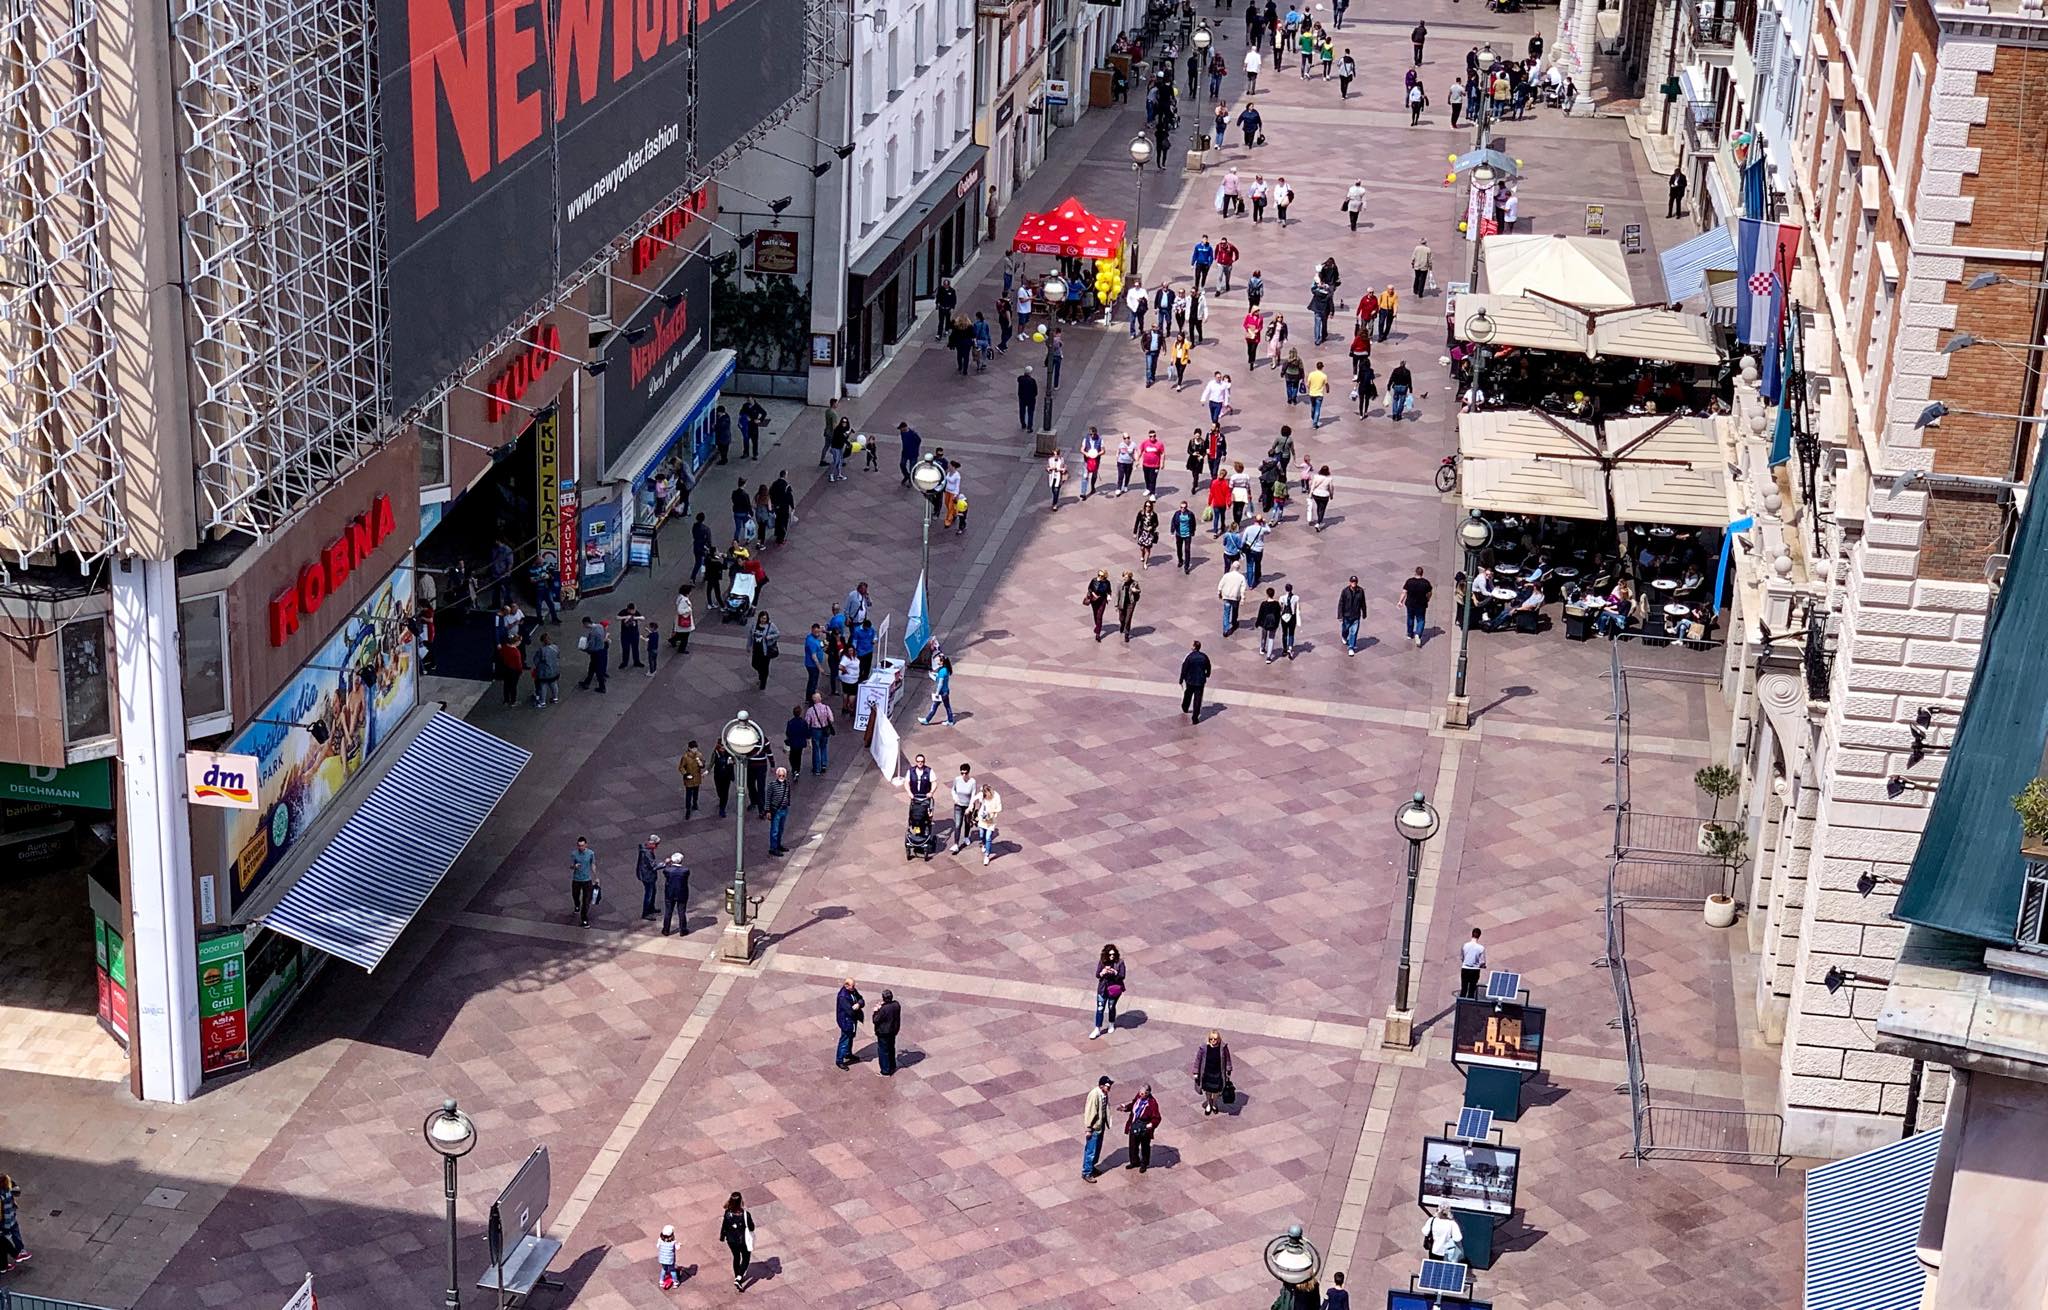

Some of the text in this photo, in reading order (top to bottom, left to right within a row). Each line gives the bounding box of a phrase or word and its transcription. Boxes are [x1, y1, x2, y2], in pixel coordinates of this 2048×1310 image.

[567, 123, 679, 223] www.newyorker.fashion
[541, 415, 556, 546] KUP ZLATA
[269, 492, 397, 648] ROBNA
[564, 525, 573, 580] AUTOMAT
[10, 783, 80, 799] DEICHMANN
[203, 764, 245, 789] dm
[221, 940, 240, 950] CITY
[212, 996, 234, 1009] Grill
